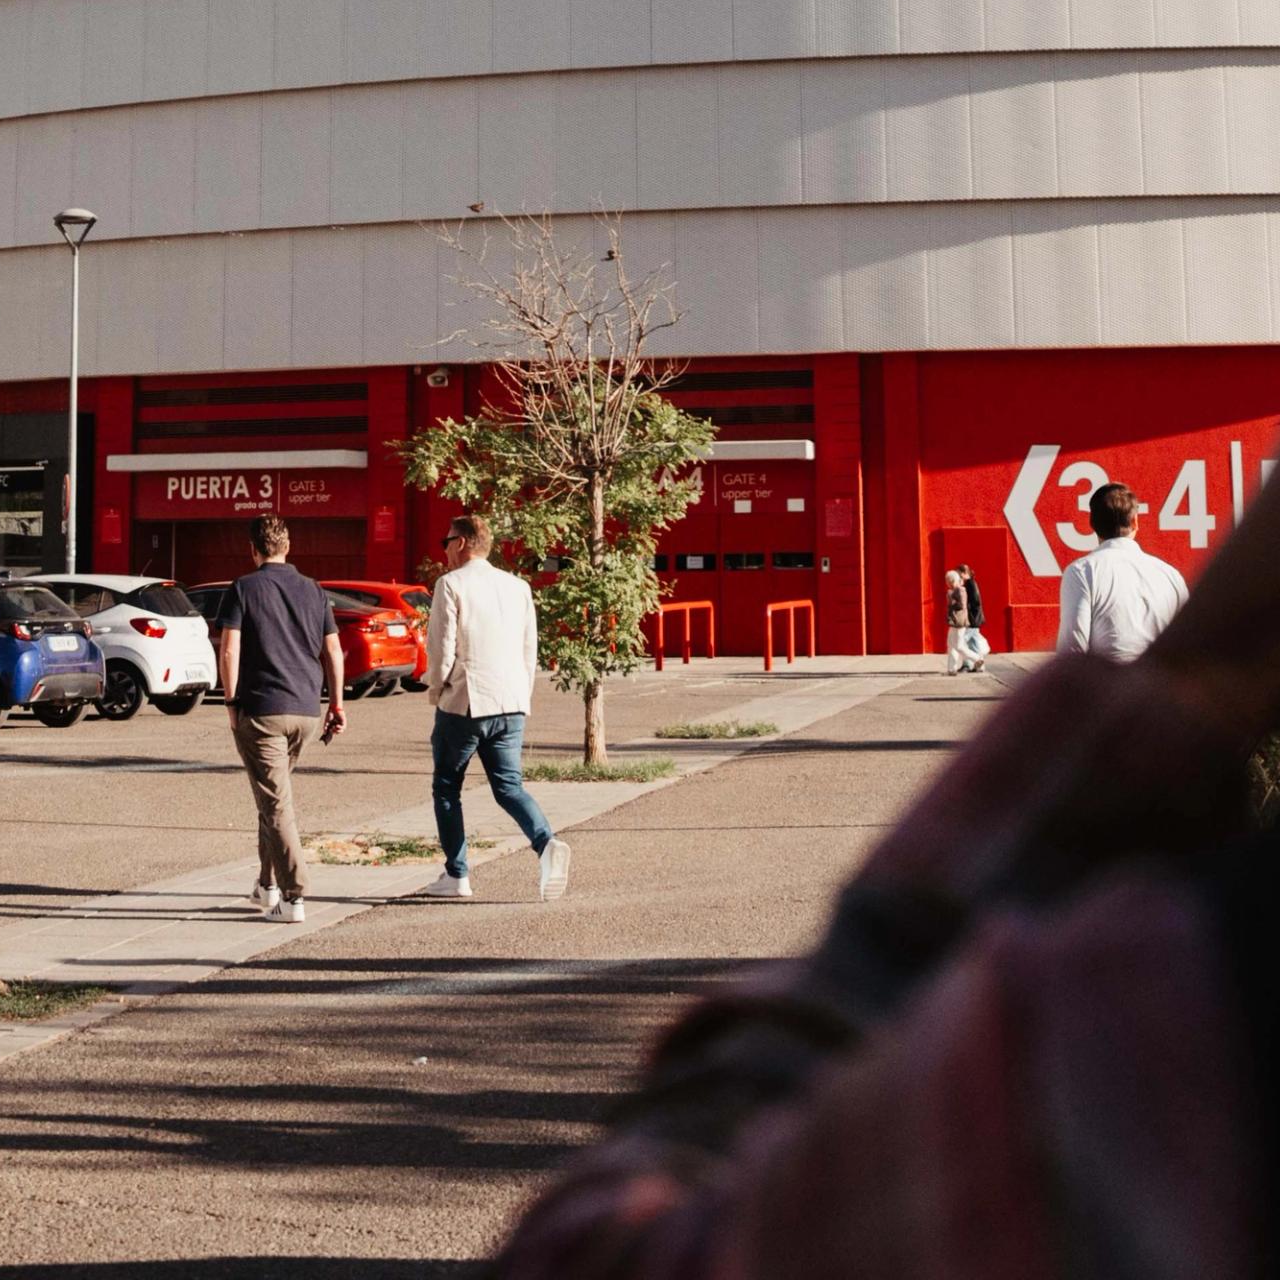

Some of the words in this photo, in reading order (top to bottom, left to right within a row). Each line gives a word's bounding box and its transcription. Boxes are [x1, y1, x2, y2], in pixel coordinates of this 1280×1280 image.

[722, 473, 756, 485] GATE
[758, 473, 767, 485] 4
[167, 476, 250, 500] PUERTA
[259, 475, 273, 499] 3
[288, 481, 317, 493] GATE
[319, 480, 326, 492] 3
[288, 494, 314, 504] upper
[316, 492, 332, 503] tier
[721, 490, 751, 501] upper
[754, 488, 773, 499] tier
[234, 501, 257, 511] grada
